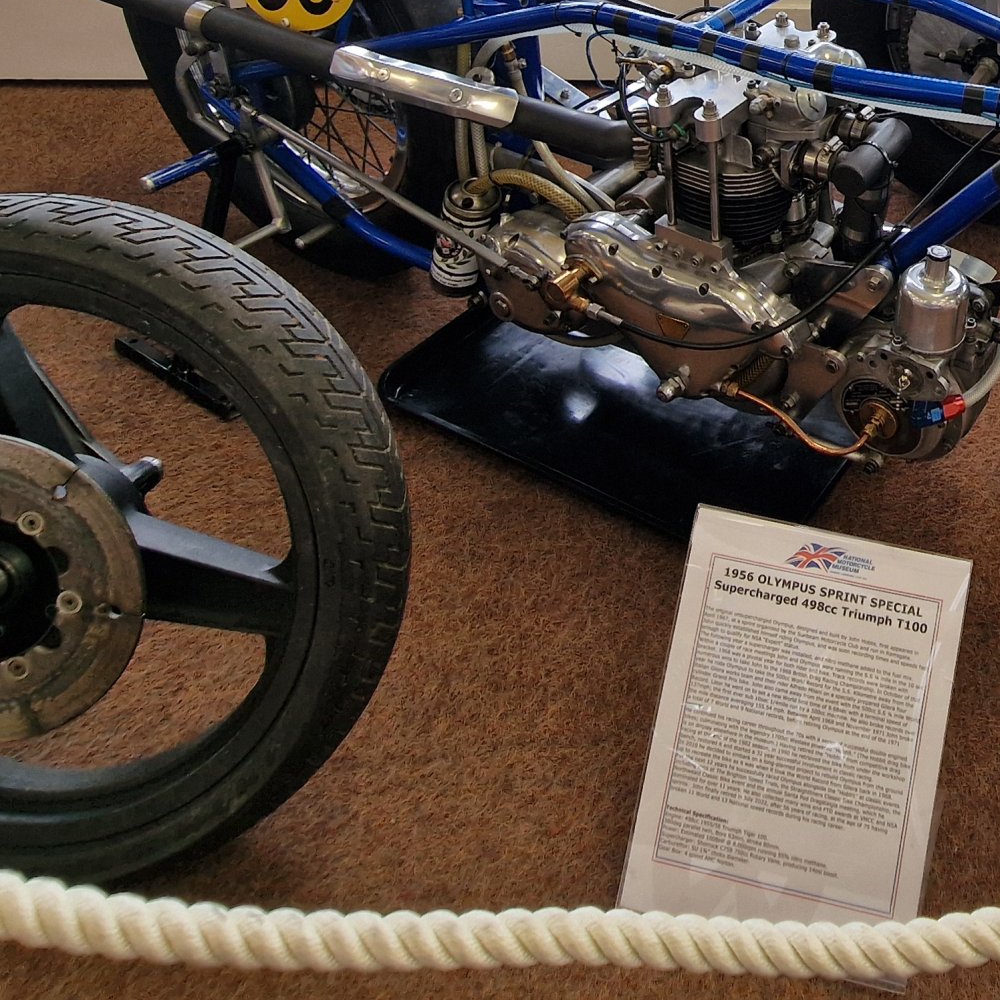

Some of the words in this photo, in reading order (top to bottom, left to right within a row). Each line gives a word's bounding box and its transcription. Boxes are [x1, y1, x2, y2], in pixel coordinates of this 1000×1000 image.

[837, 559, 876, 571] MOTORCYCLE
[843, 555, 873, 565] NATIONAL
[832, 564, 860, 574] MUSEUM
[724, 567, 755, 582] 1956
[757, 574, 817, 595] OLYMPUS
[819, 587, 867, 606] SPRINT
[869, 597, 923, 617] SPECIAL
[714, 580, 799, 606] Supercharged
[801, 598, 838, 615] 498cc
[841, 606, 893, 626] Triumph
[896, 618, 928, 634] T100
